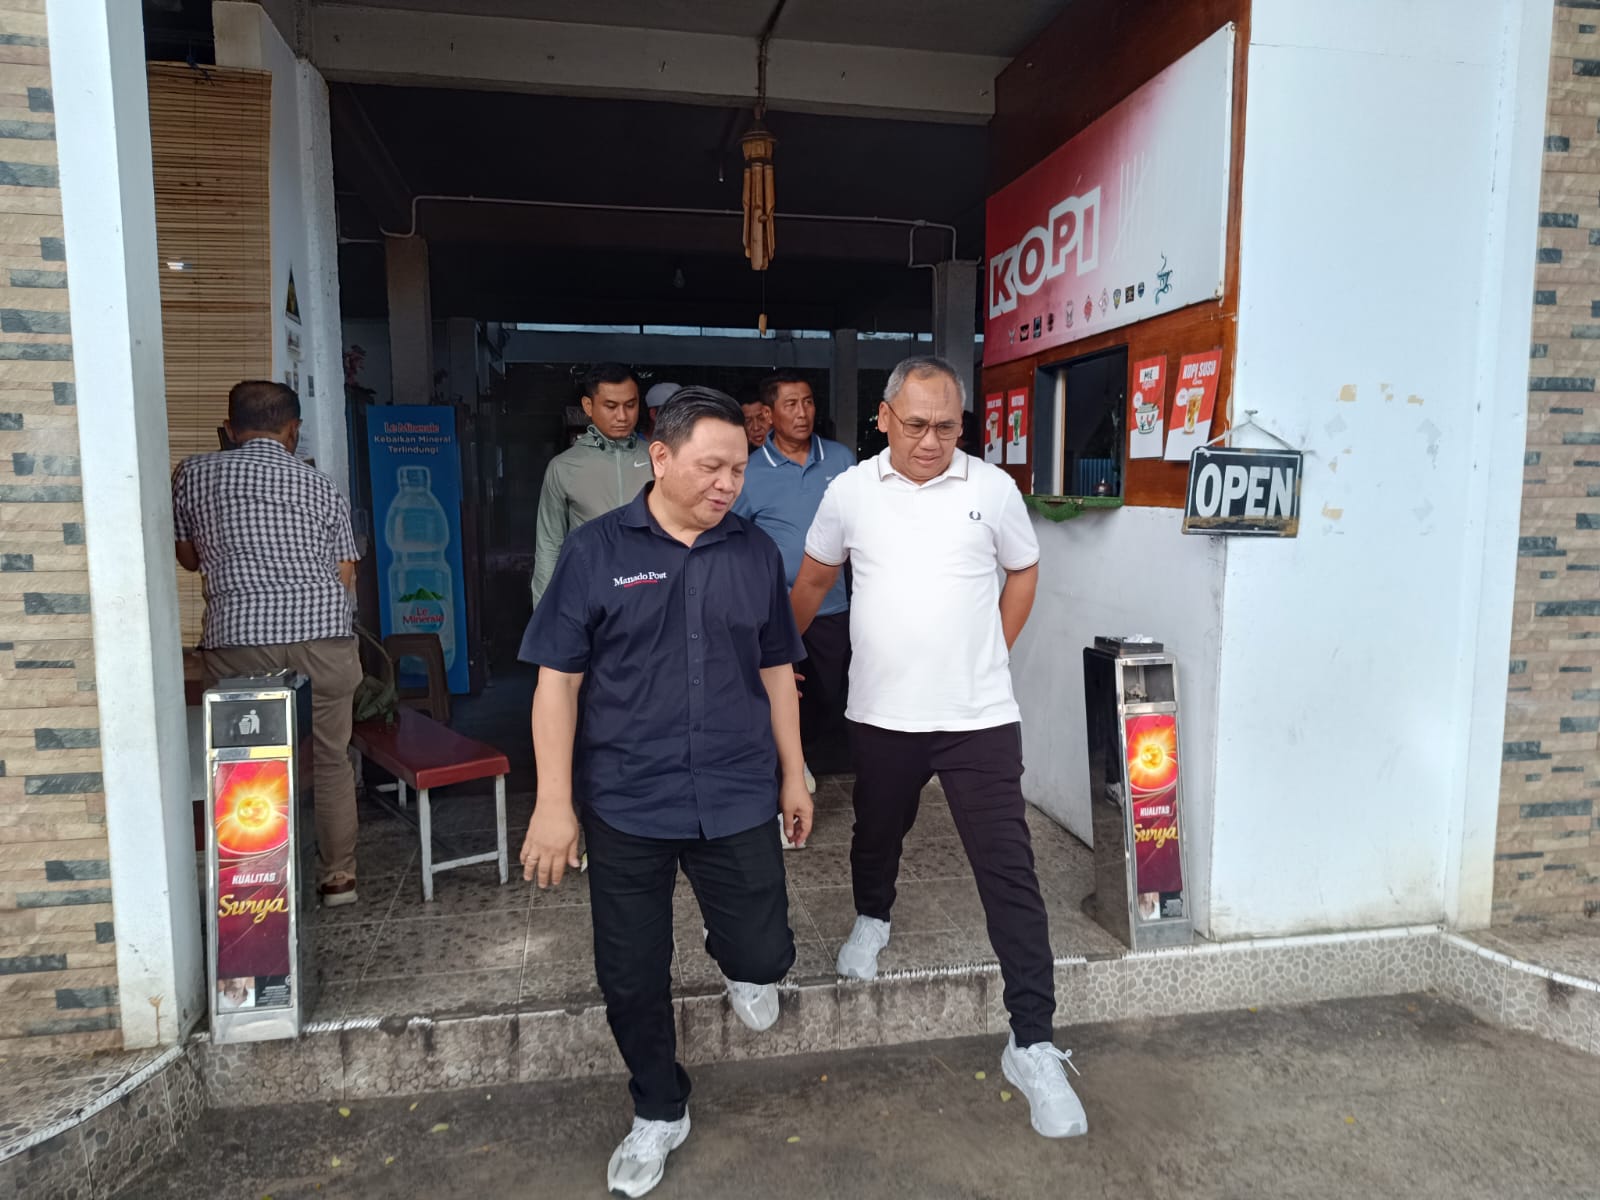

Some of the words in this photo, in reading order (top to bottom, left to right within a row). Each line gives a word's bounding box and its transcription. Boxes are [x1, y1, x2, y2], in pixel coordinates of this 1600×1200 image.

[990, 186, 1101, 319] KOPI
[374, 435, 416, 443] Kebaikan
[418, 435, 451, 443] Mineral
[388, 445, 439, 455] Terlindungi
[1195, 462, 1294, 520] OPEN
[613, 572, 648, 587] Manado
[648, 571, 667, 580] Post
[416, 607, 428, 616] Le
[1139, 805, 1170, 817] KUALITAS
[1134, 823, 1179, 849] Surya
[231, 872, 276, 885] KUALITAS
[218, 894, 289, 924] Surya
